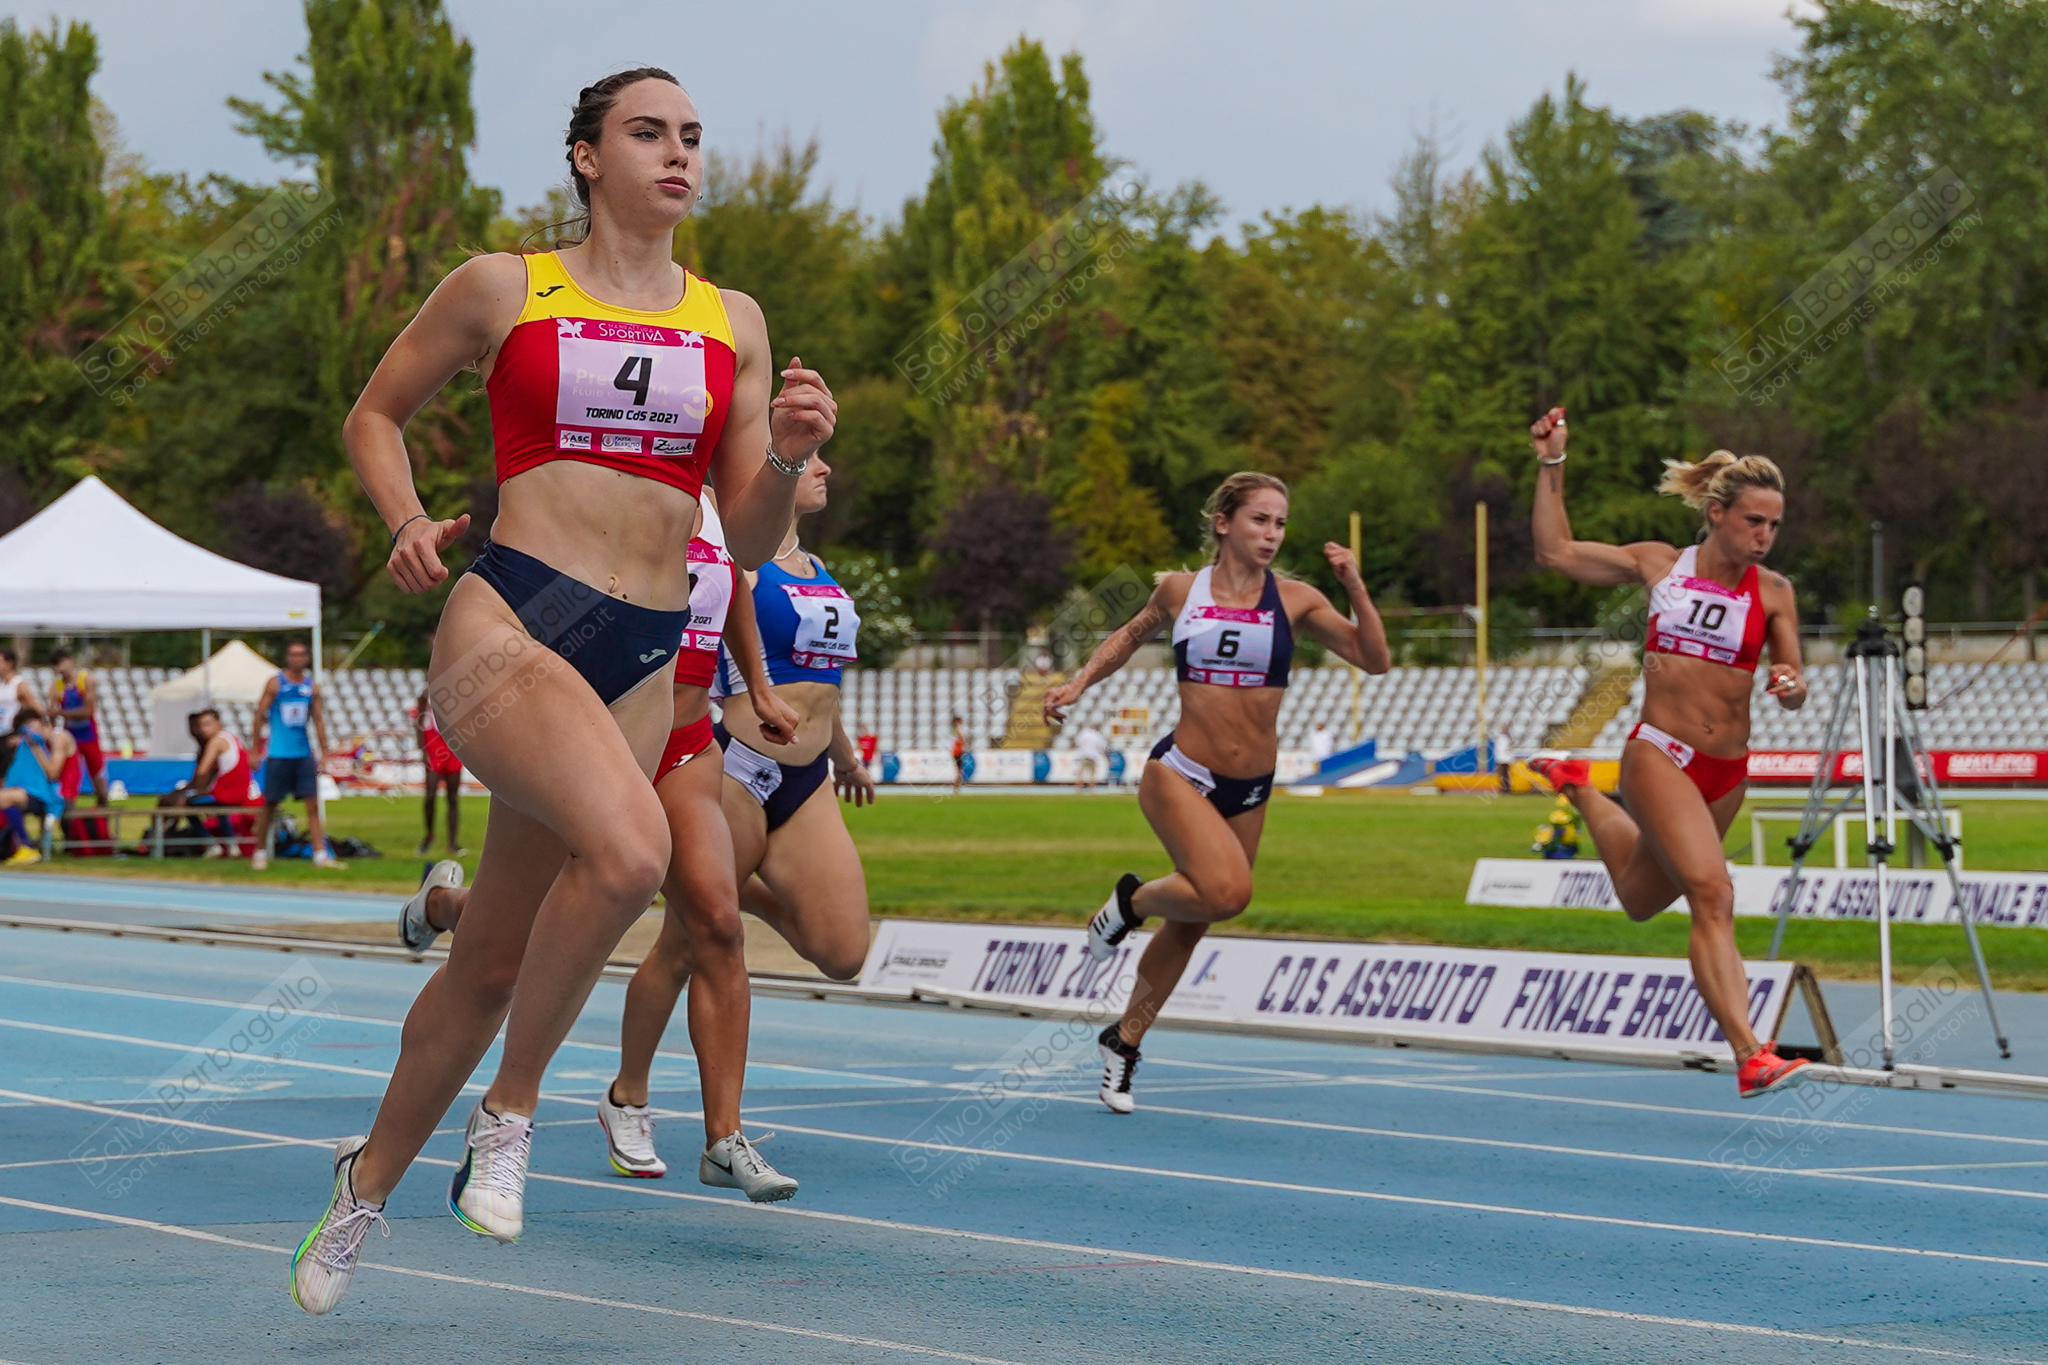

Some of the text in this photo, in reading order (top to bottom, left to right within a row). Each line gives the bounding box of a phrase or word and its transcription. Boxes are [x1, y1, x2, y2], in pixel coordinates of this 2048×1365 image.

[598, 322, 666, 343] SPORTIVA
[613, 356, 653, 406] 4
[586, 407, 679, 425] TORINO CdS 2021
[570, 434, 590, 443] ASC
[693, 615, 712, 625] 2021
[823, 605, 839, 639] 2
[1687, 599, 1727, 630] 10
[1217, 630, 1240, 658] 6
[971, 939, 1131, 999] TORINO 2021
[1329, 958, 1498, 1024] ASSOLUTO
[1501, 968, 1635, 1035] FINALE
[1620, 973, 1775, 1042] BRONO
